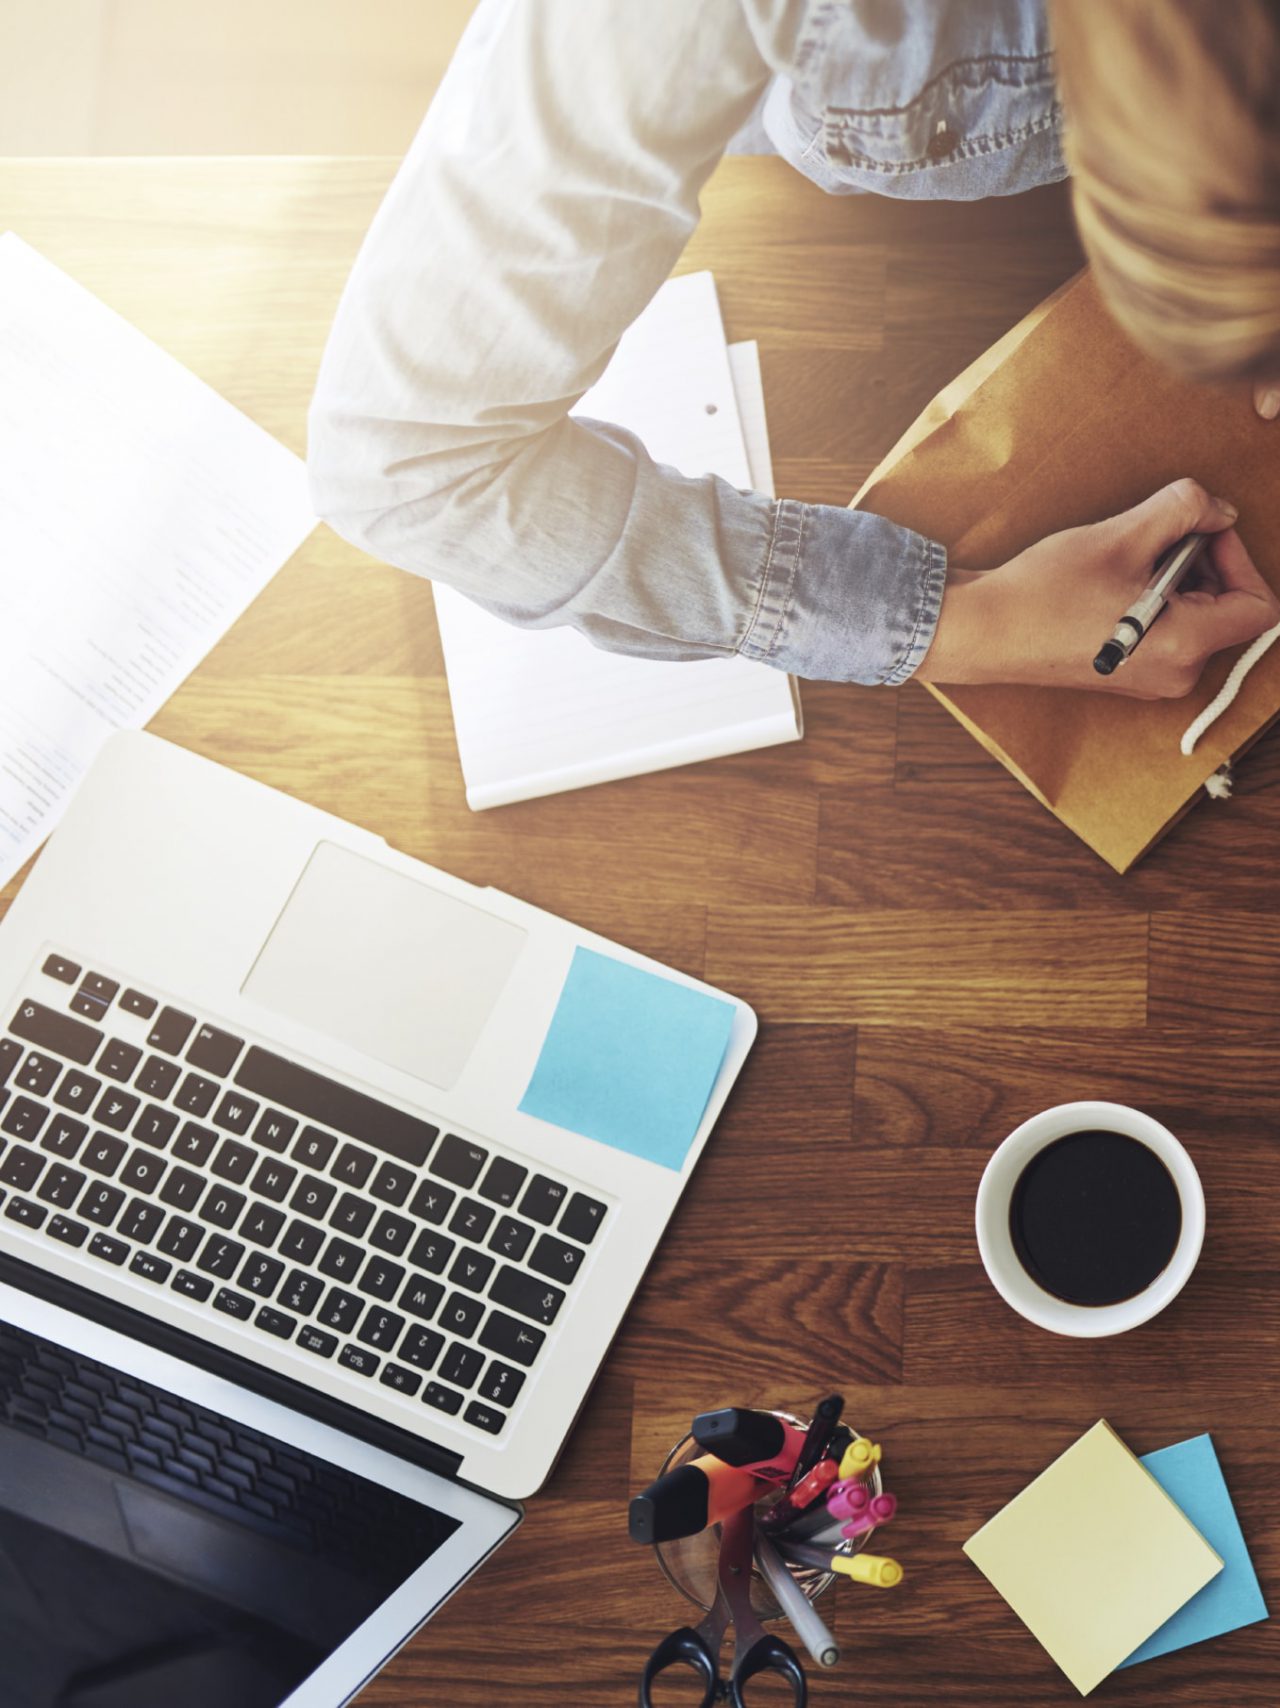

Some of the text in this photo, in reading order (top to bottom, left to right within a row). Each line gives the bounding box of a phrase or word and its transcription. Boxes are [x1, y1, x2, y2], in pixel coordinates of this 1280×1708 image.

[108, 1102, 122, 1114] Æ
[228, 1105, 242, 1119] M
[152, 1120, 159, 1133] L
[268, 1124, 280, 1137] N
[188, 1137, 199, 1150] K
[308, 1142, 318, 1154] B
[97, 1149, 108, 1160] P
[229, 1156, 237, 1167] J
[346, 1161, 356, 1173] V
[137, 1166, 148, 1177] O
[266, 1173, 278, 1186] H
[386, 1178, 397, 1190] C
[100, 1191, 108, 1202] 0
[306, 1192, 317, 1203] G
[426, 1196, 437, 1208] X
[215, 1201, 227, 1213] U
[138, 1210, 146, 1220] 9
[346, 1211, 356, 1222] F
[465, 1214, 476, 1227] Z
[255, 1219, 265, 1231] Y
[179, 1227, 188, 1238] 8
[386, 1228, 397, 1240] D
[296, 1238, 304, 1249] T
[218, 1245, 227, 1255] 7
[426, 1246, 435, 1257] S
[336, 1255, 345, 1266] R
[260, 1262, 267, 1273] 6
[466, 1264, 476, 1276] A
[252, 1276, 261, 1287] &
[376, 1273, 385, 1285] E
[298, 1281, 307, 1292] 5
[291, 1294, 300, 1306] %
[338, 1298, 347, 1308] 4
[413, 1291, 427, 1305] W
[330, 1312, 340, 1323] €
[455, 1310, 466, 1322] Q
[379, 1317, 387, 1328] 3
[418, 1335, 428, 1347] 2
[476, 1414, 489, 1424] esc
